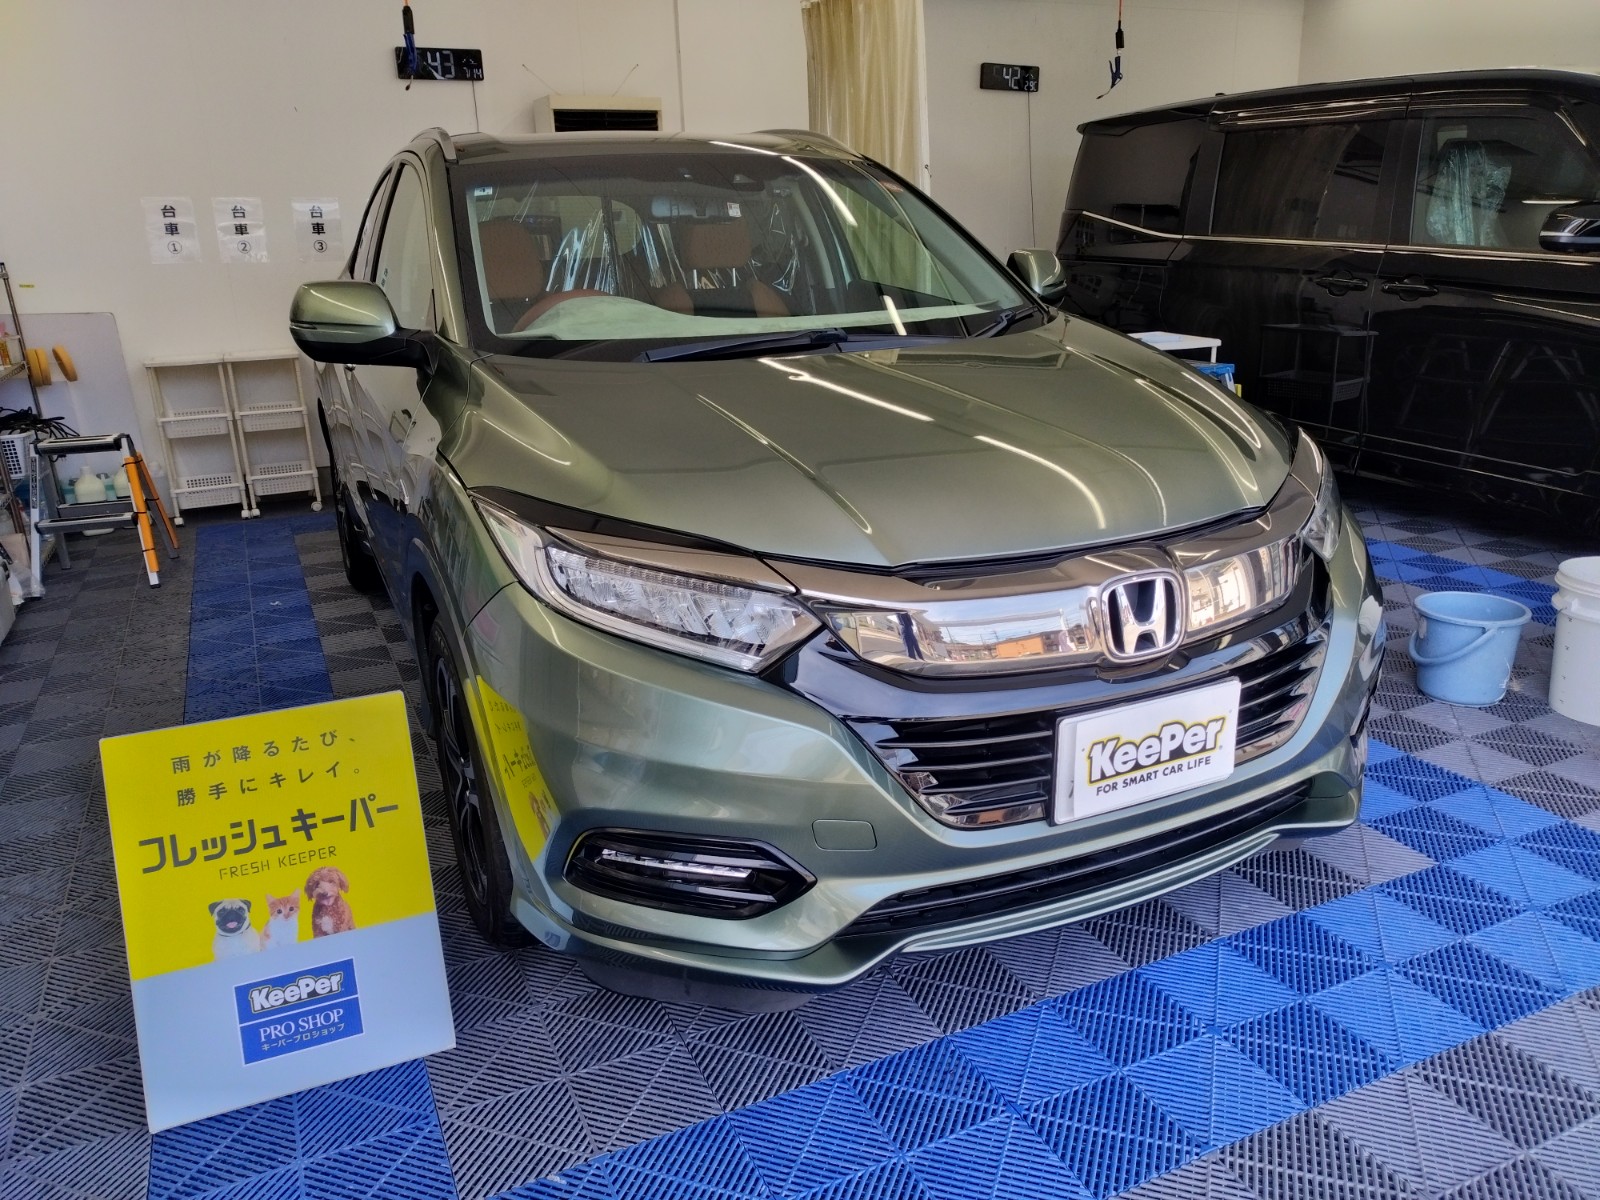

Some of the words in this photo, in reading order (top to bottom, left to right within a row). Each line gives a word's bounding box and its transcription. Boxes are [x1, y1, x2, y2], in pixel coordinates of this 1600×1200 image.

[171, 730, 356, 774] 雨が降るたび、
[1088, 716, 1226, 785] KeePer
[177, 761, 359, 807] 勝手にキレイ。
[1096, 782, 1118, 796] FOR
[1122, 770, 1159, 789] SMART
[1162, 763, 1183, 777] CAR
[1187, 756, 1211, 770] LIFE
[138, 793, 399, 874] フレッシュキーパー
[219, 860, 270, 880] FRESH
[278, 845, 337, 868] KEEPER
[249, 972, 343, 1013] KeePer
[259, 1021, 295, 1042] PRO
[298, 1008, 344, 1032] SHOP
